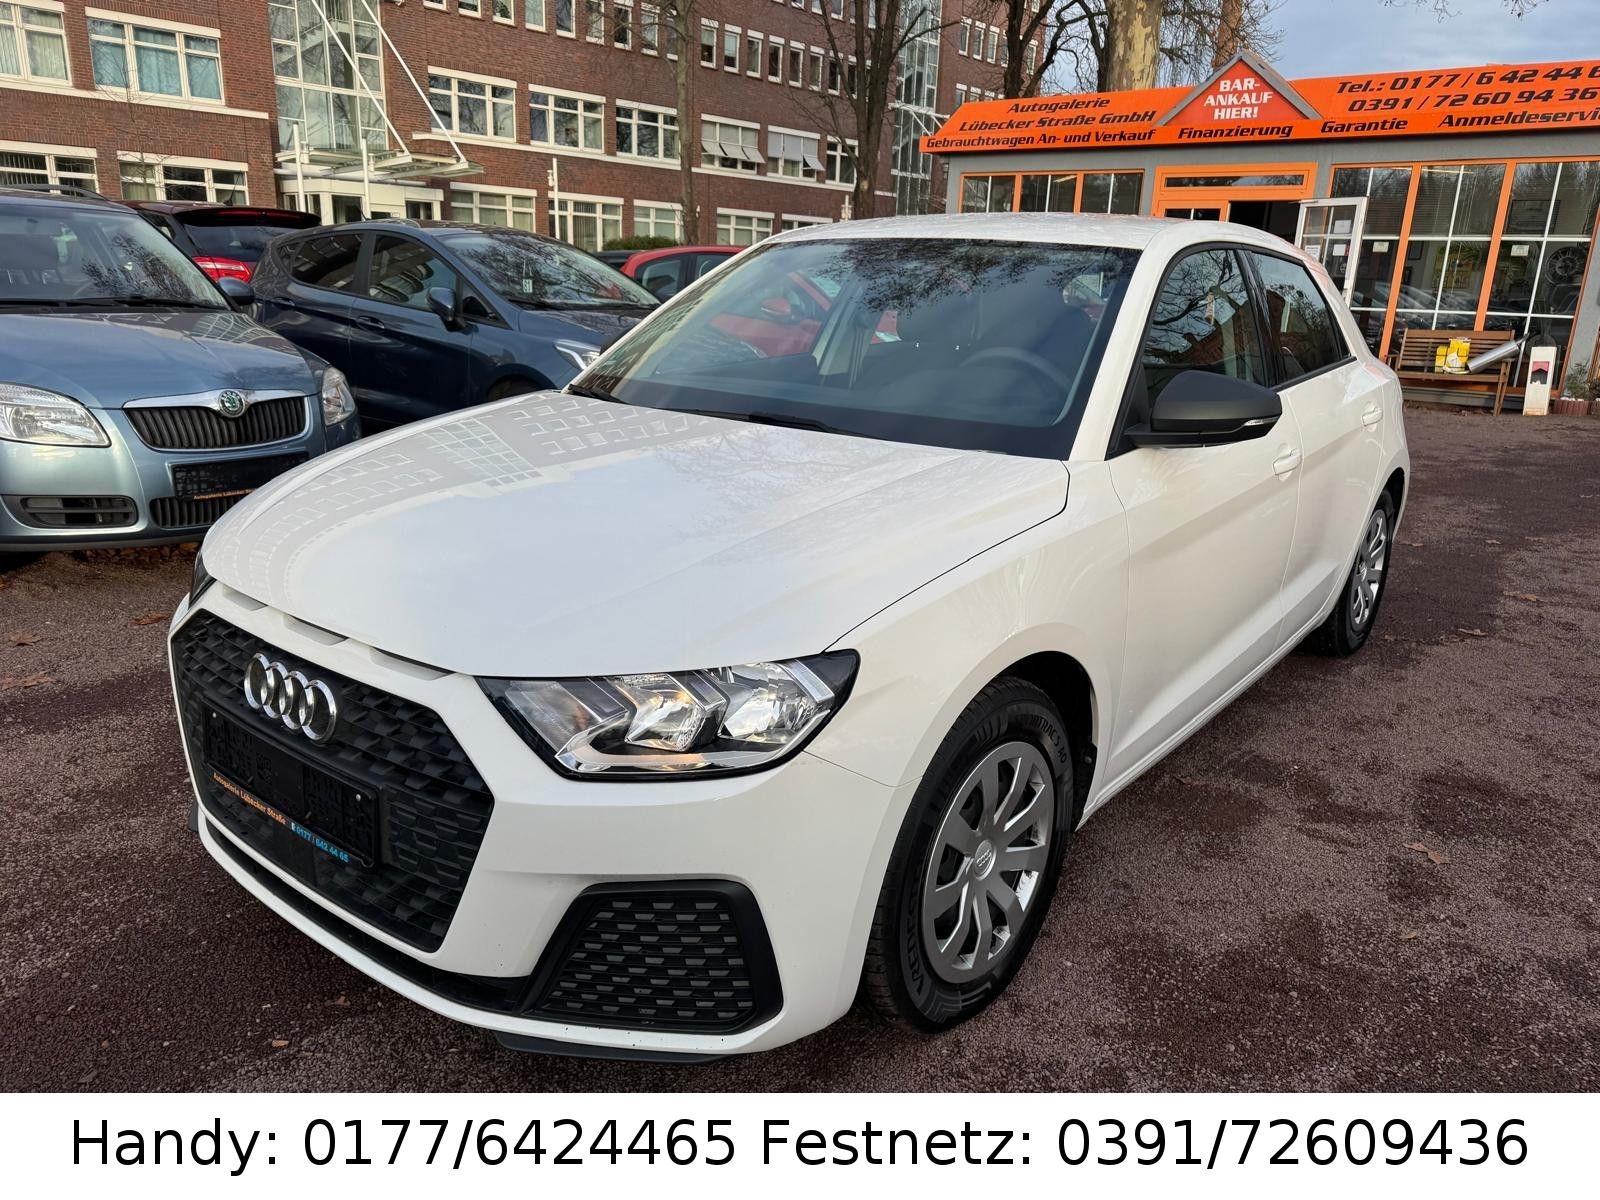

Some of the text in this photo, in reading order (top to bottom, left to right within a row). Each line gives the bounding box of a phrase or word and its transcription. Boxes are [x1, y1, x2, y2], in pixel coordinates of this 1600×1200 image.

[1219, 77, 1260, 92] BAR-
[1337, 80, 1386, 93] Tel.:
[1499, 70, 1539, 83] 42
[1543, 67, 1584, 81] 44
[1007, 98, 1110, 113] Autogalerie
[1203, 92, 1273, 107] ANKAUF
[1348, 97, 1413, 112] 0391
[1433, 93, 1469, 108] 72
[1472, 91, 1512, 105] 60
[1514, 89, 1555, 103] 94
[1559, 87, 1600, 101] 36
[1213, 106, 1259, 120] HIER!
[1438, 107, 1600, 128] Anmeldeservi
[959, 110, 1157, 132] Lübecker Straße GmbH
[1321, 118, 1408, 133] Garantie
[926, 129, 1156, 148] Gebrauchtwagen An- und Verkauf
[1178, 125, 1293, 139] Finanzierung
